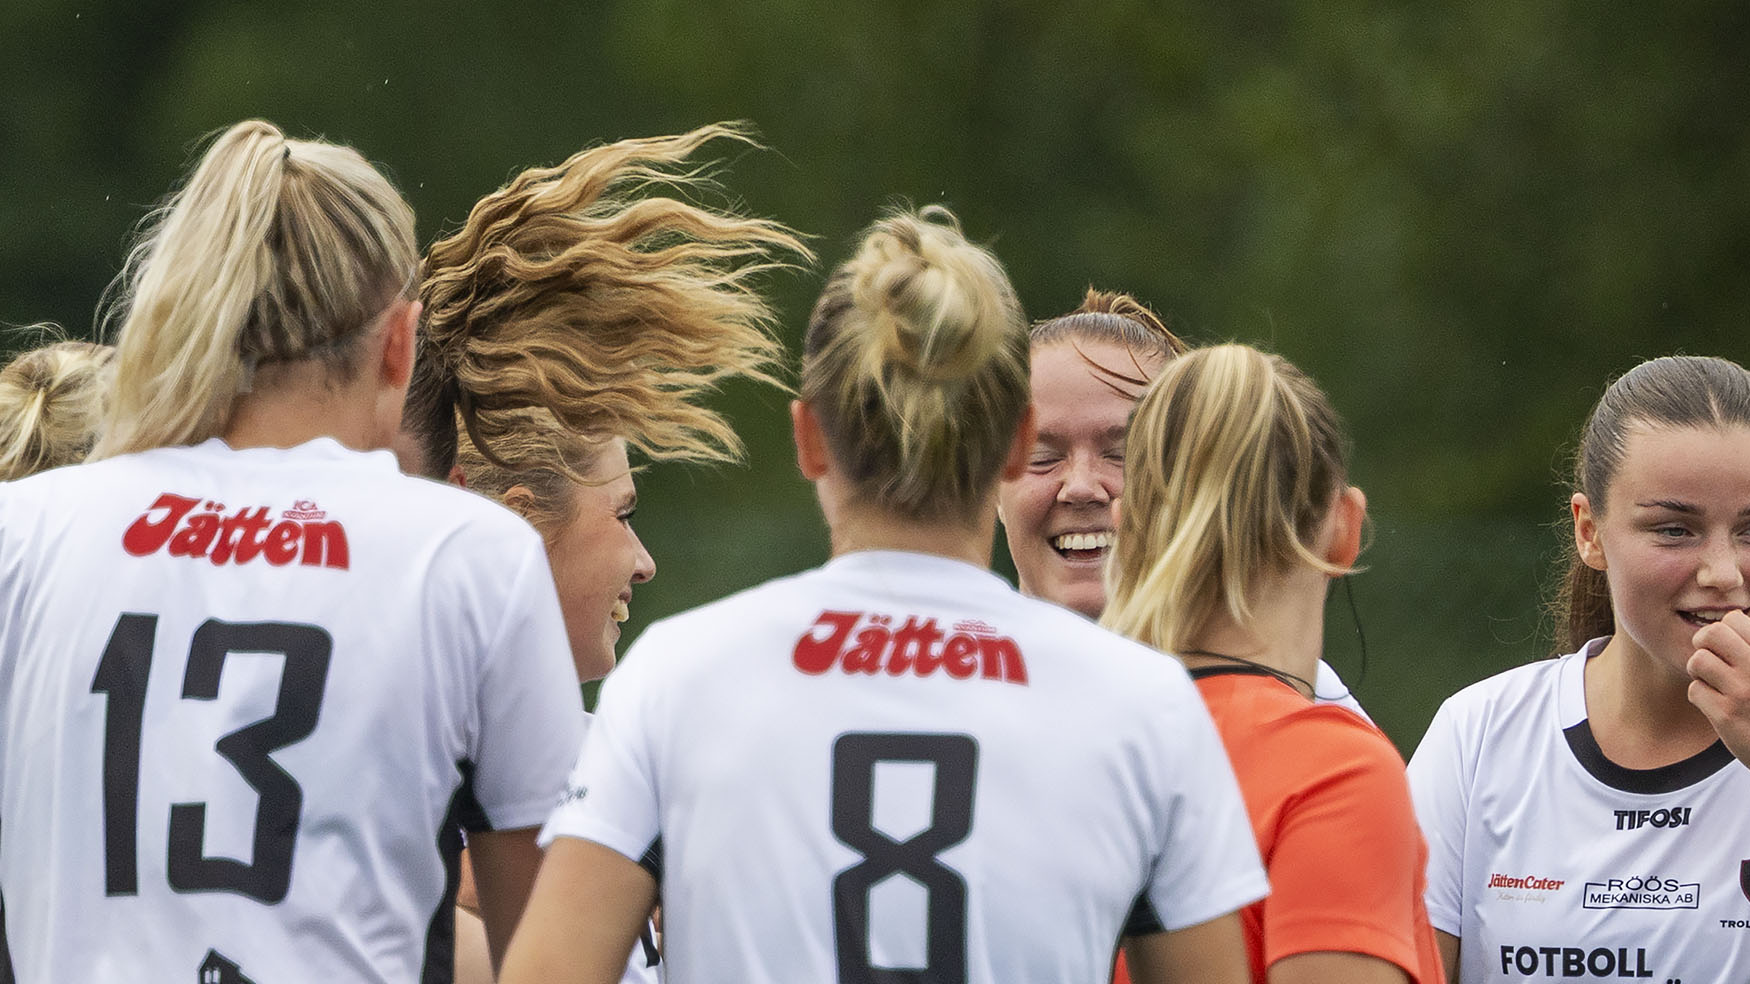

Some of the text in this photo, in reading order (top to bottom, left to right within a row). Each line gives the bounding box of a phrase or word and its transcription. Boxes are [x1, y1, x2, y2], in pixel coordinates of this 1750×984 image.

[121, 492, 350, 571] Jätten
[791, 609, 1030, 687] Jätten
[90, 611, 334, 905] 13
[1614, 807, 1692, 831] TIFOSI
[1589, 892, 1694, 905] MEKANISKA AB
[1607, 875, 1680, 892] RÖÖS
[1500, 945, 1653, 978] FOTBOLL
